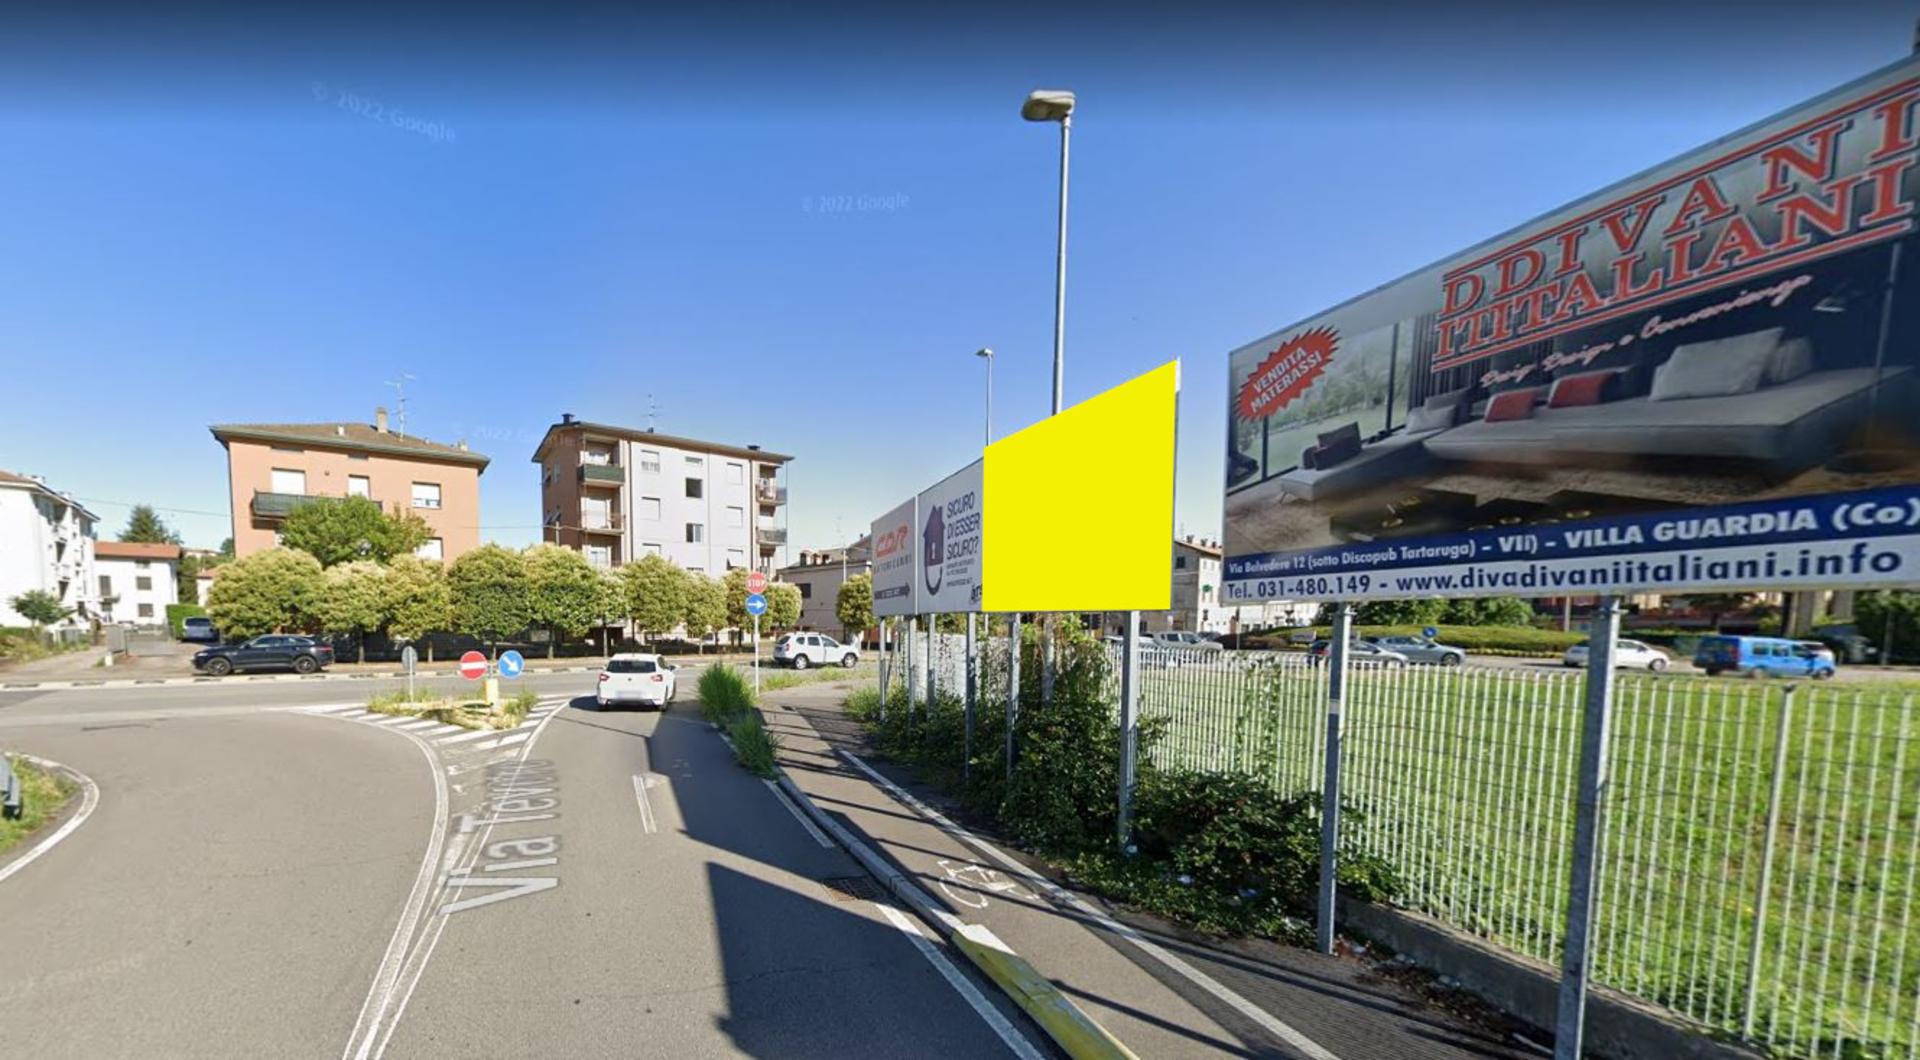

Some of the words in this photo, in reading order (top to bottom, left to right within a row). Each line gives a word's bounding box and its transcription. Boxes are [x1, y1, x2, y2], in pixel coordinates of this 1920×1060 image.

[1251, 351, 1323, 413] MATERASSI
[1253, 346, 1307, 393] VENDITA
[946, 491, 975, 518] SICURO
[946, 521, 955, 540] DI
[955, 512, 980, 538] ESSER
[946, 536, 979, 560] SICURO?
[1229, 563, 1243, 574] Via
[1294, 556, 1305, 570] 12
[1308, 554, 1339, 570] (sotto
[1342, 547, 1398, 565] Discopub
[1401, 539, 1476, 560] Tartaruga)
[1564, 525, 1644, 549] VILLA
[1653, 508, 1818, 542] GUARDIA
[1832, 498, 1920, 532] (Co)
[1228, 582, 1253, 599] Tel.
[1258, 575, 1371, 599] 031-480.149
[1396, 543, 1902, 591] www.divadivaniitaliani.info
